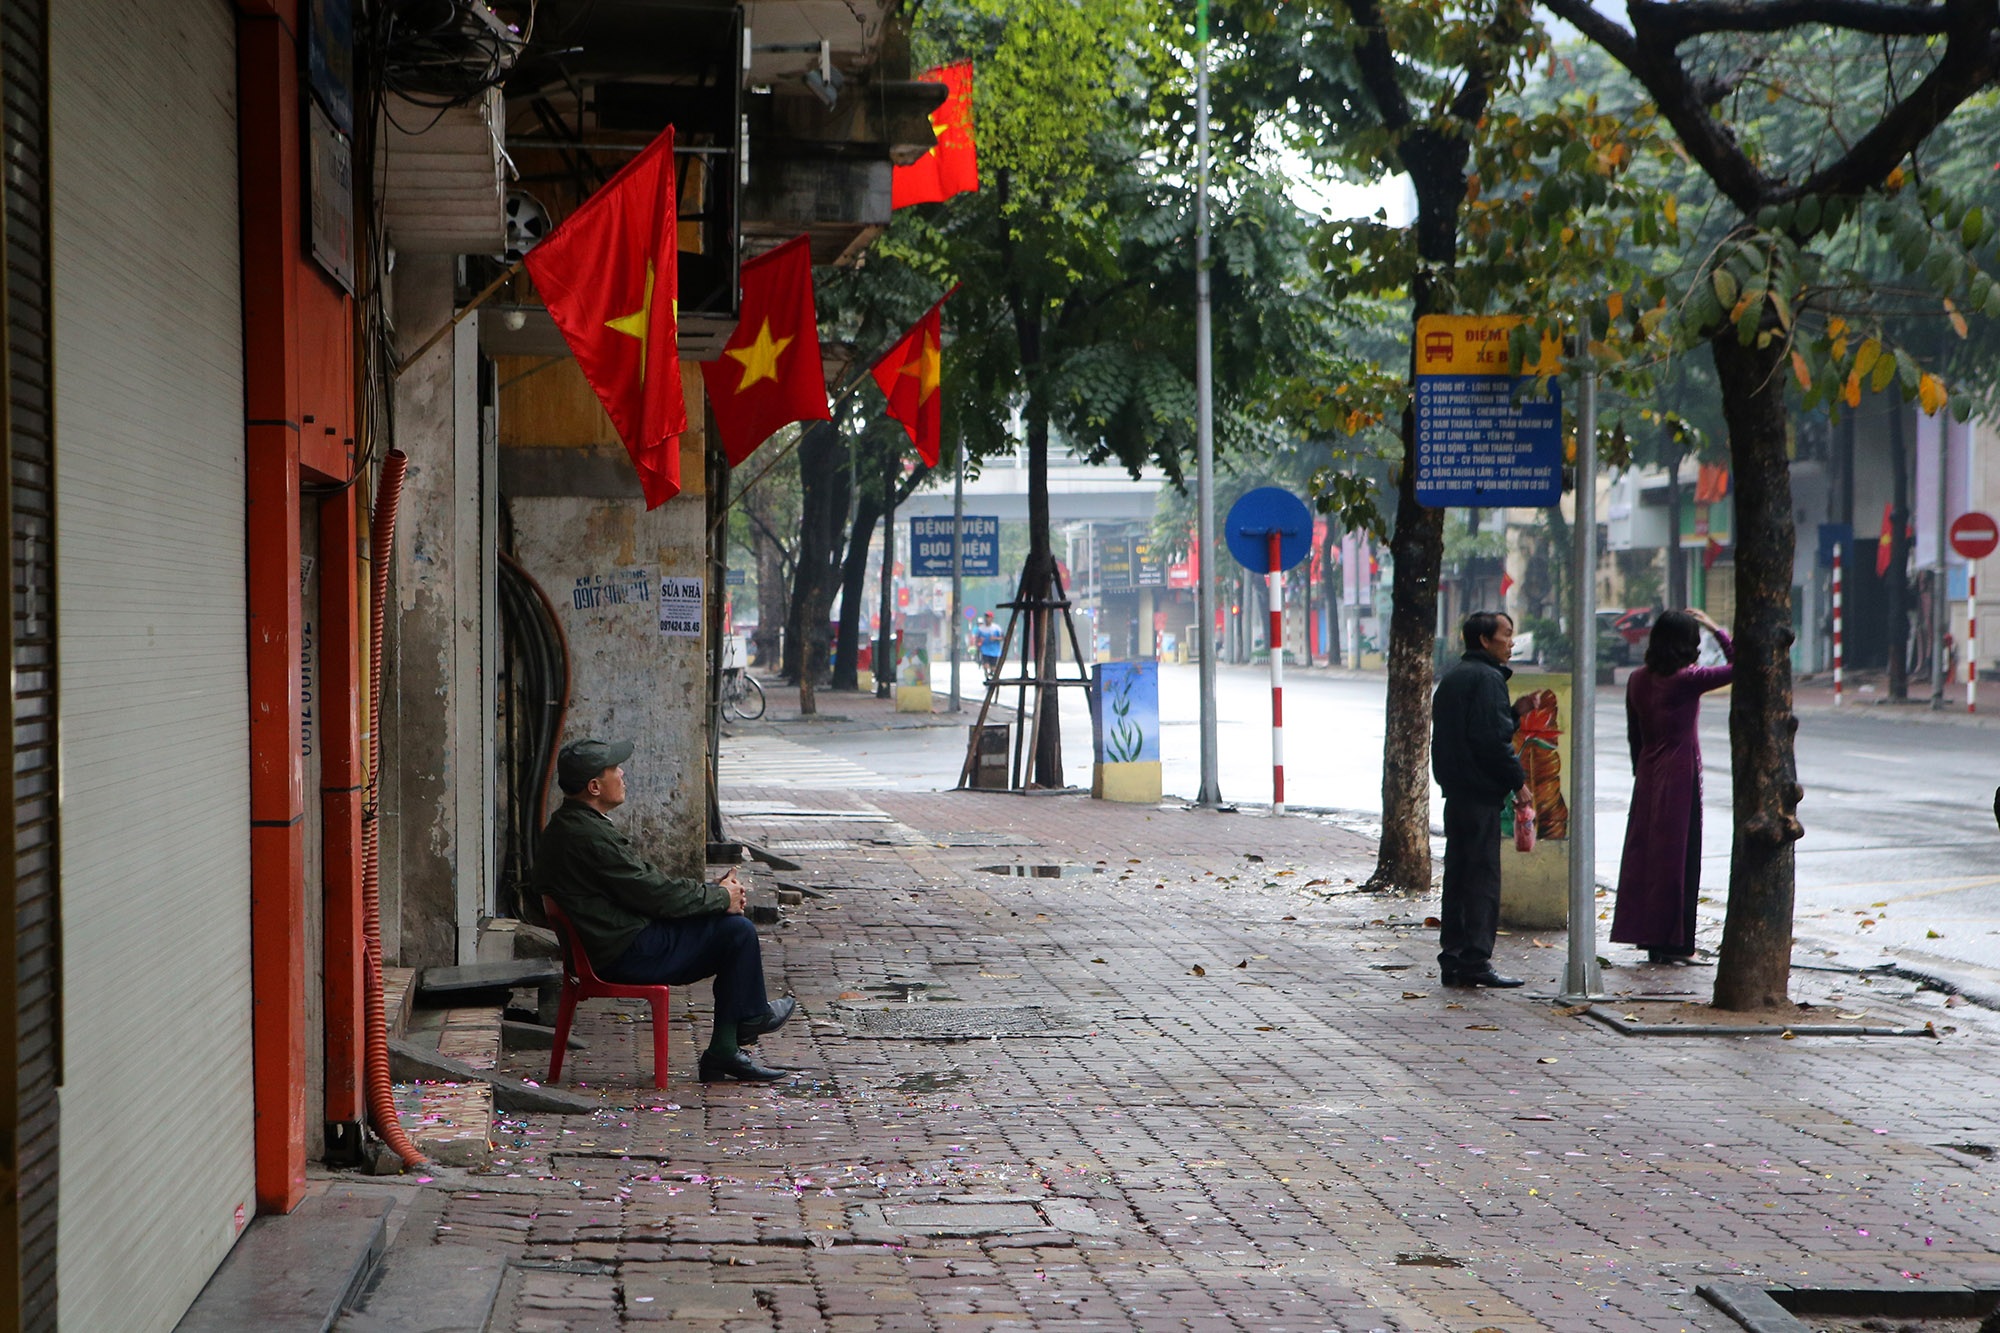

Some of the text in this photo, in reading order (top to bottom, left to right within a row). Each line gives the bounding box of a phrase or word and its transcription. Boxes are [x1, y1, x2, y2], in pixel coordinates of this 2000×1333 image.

[1477, 351, 1494, 363] XE
[915, 518, 996, 538] BỆNH VIỆN
[661, 579, 680, 598] SỬA
